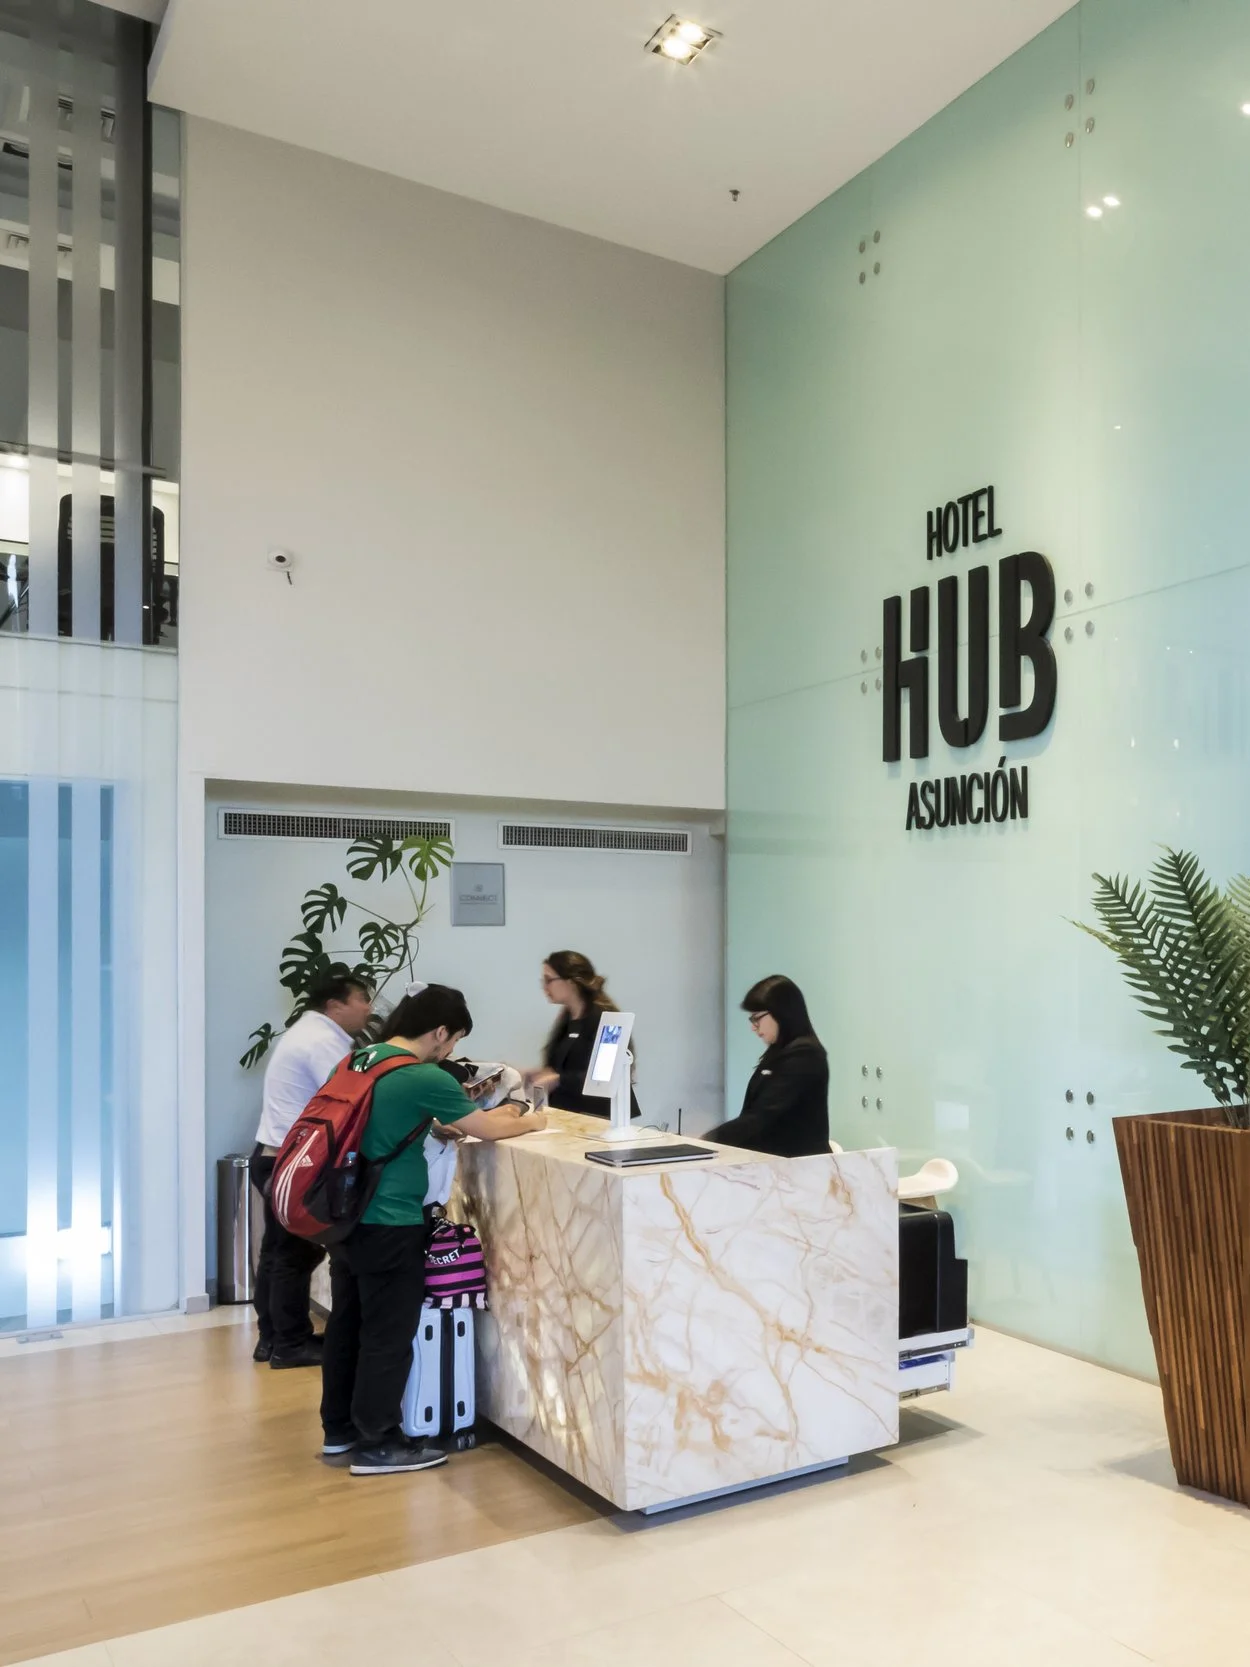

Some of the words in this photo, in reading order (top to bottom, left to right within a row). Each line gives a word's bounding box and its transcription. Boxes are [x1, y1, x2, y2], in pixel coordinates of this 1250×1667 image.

[926, 485, 1003, 560] HOTEL
[883, 551, 1057, 762] HUB
[906, 756, 1029, 831] ASUNCIÓN
